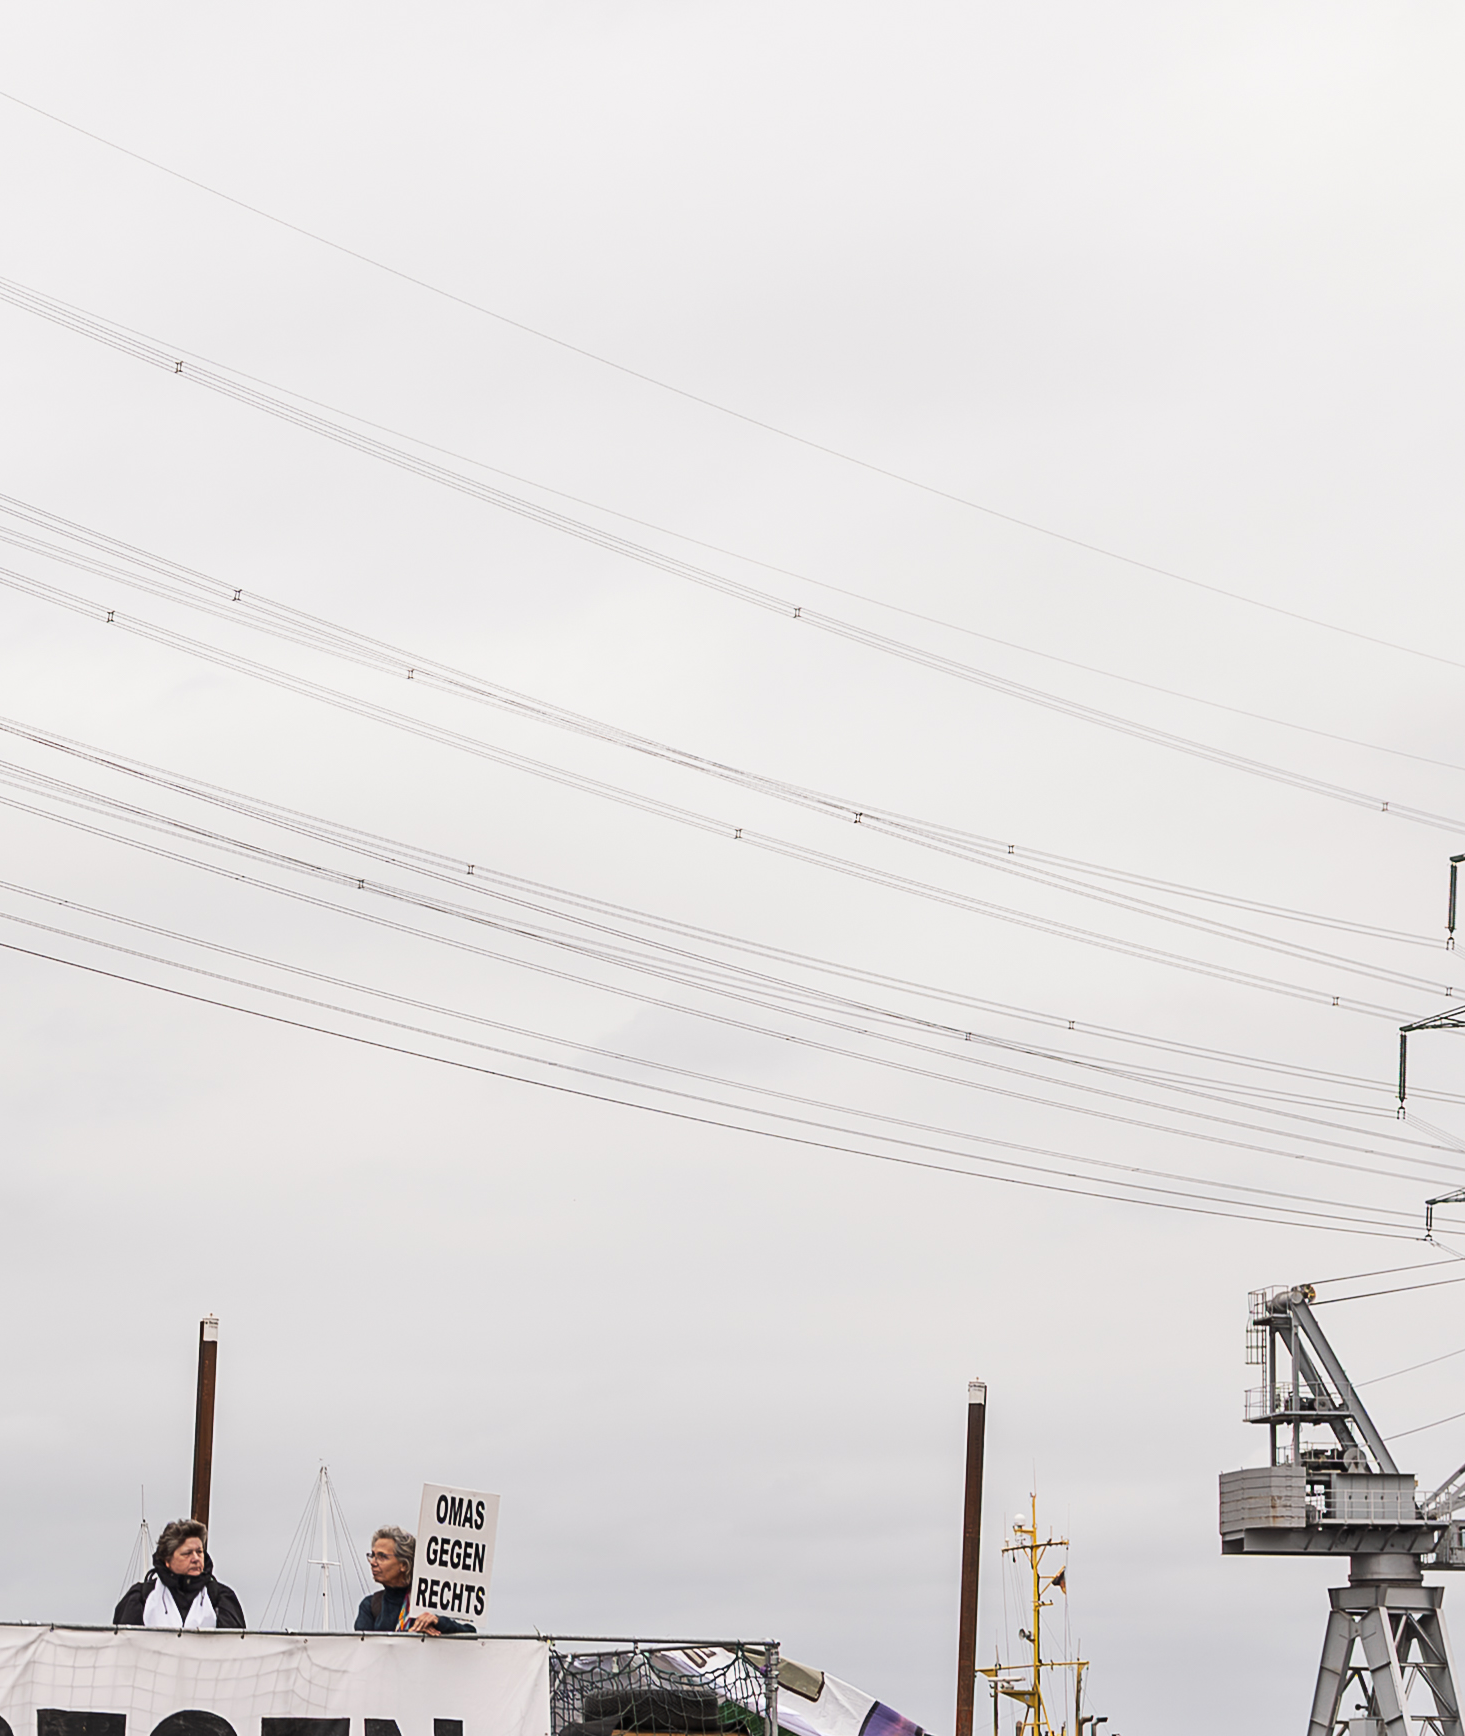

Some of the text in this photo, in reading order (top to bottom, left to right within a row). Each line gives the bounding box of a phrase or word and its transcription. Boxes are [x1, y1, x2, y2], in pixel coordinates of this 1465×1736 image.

[436, 1494, 485, 1531] OMAS
[426, 1535, 486, 1573] GEGEN
[415, 1577, 486, 1616] RECHTS
